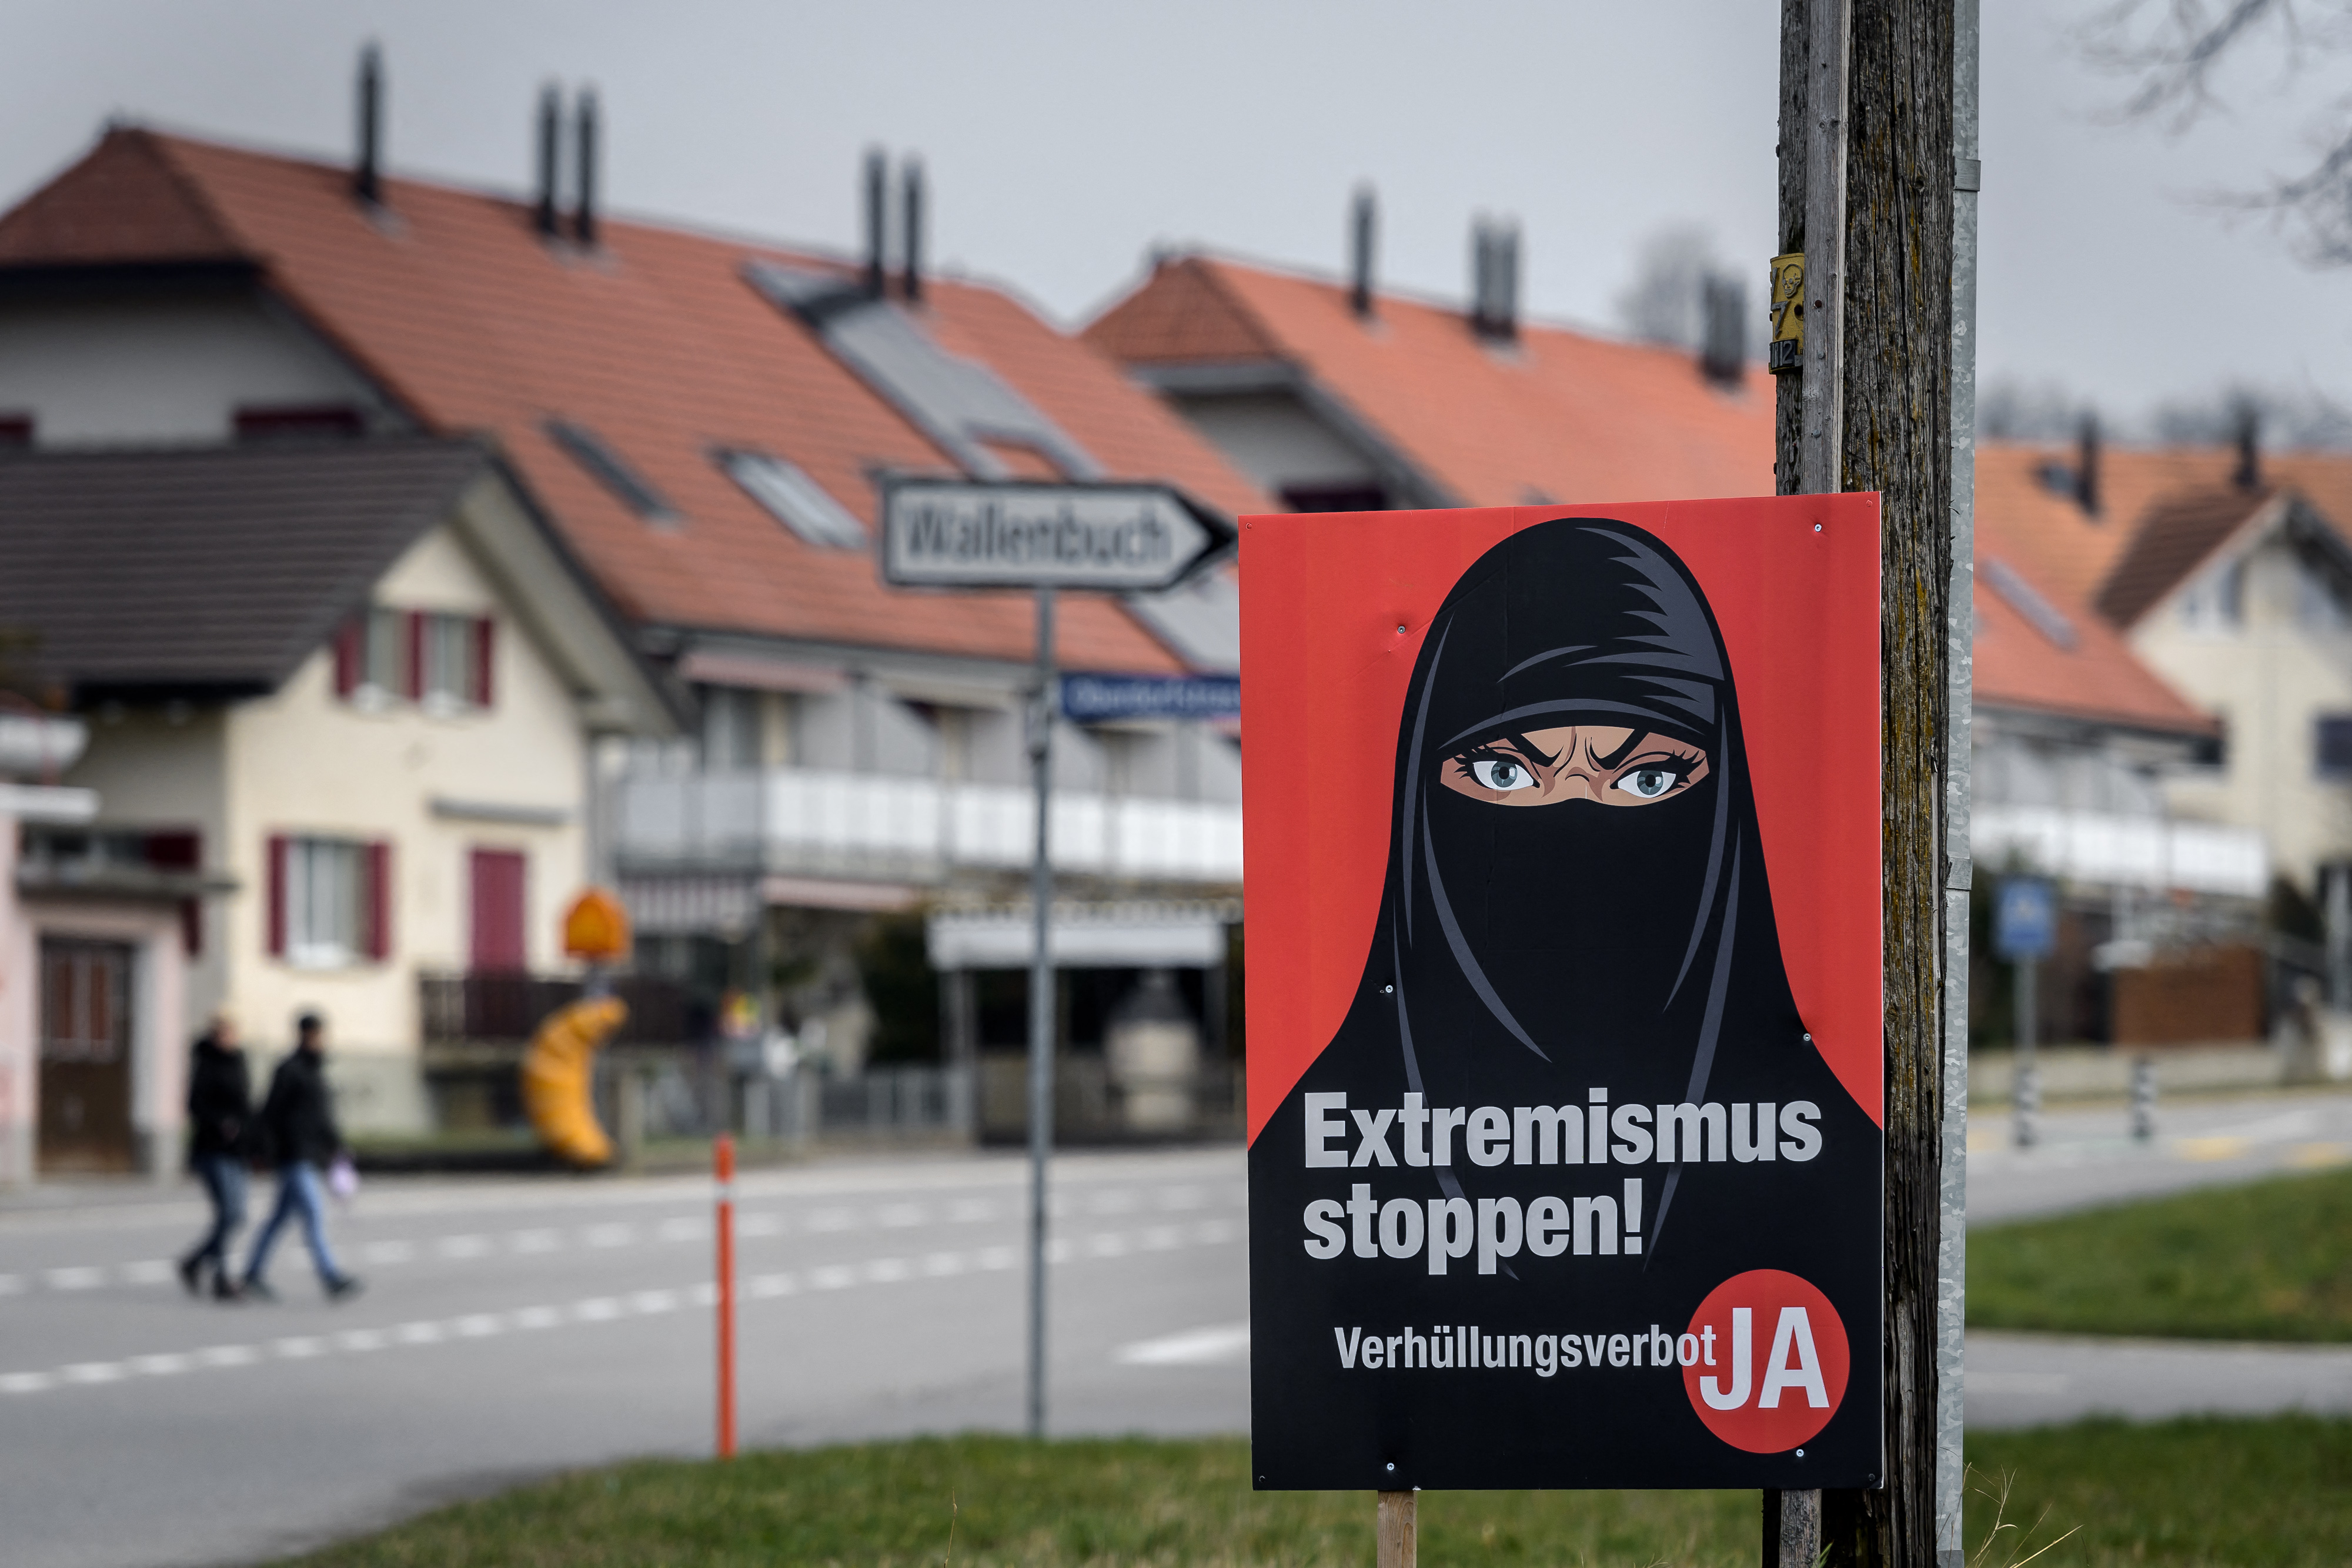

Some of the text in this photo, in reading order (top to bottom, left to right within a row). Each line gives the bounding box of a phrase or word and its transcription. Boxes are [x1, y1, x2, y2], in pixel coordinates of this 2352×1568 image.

[904, 503, 1171, 566] Wallenbuch
[1304, 1087, 1822, 1168] Extremismus
[1304, 1178, 1642, 1275] stoppen!
[1334, 1306, 1830, 1410] Verhüllungsverbot JA
